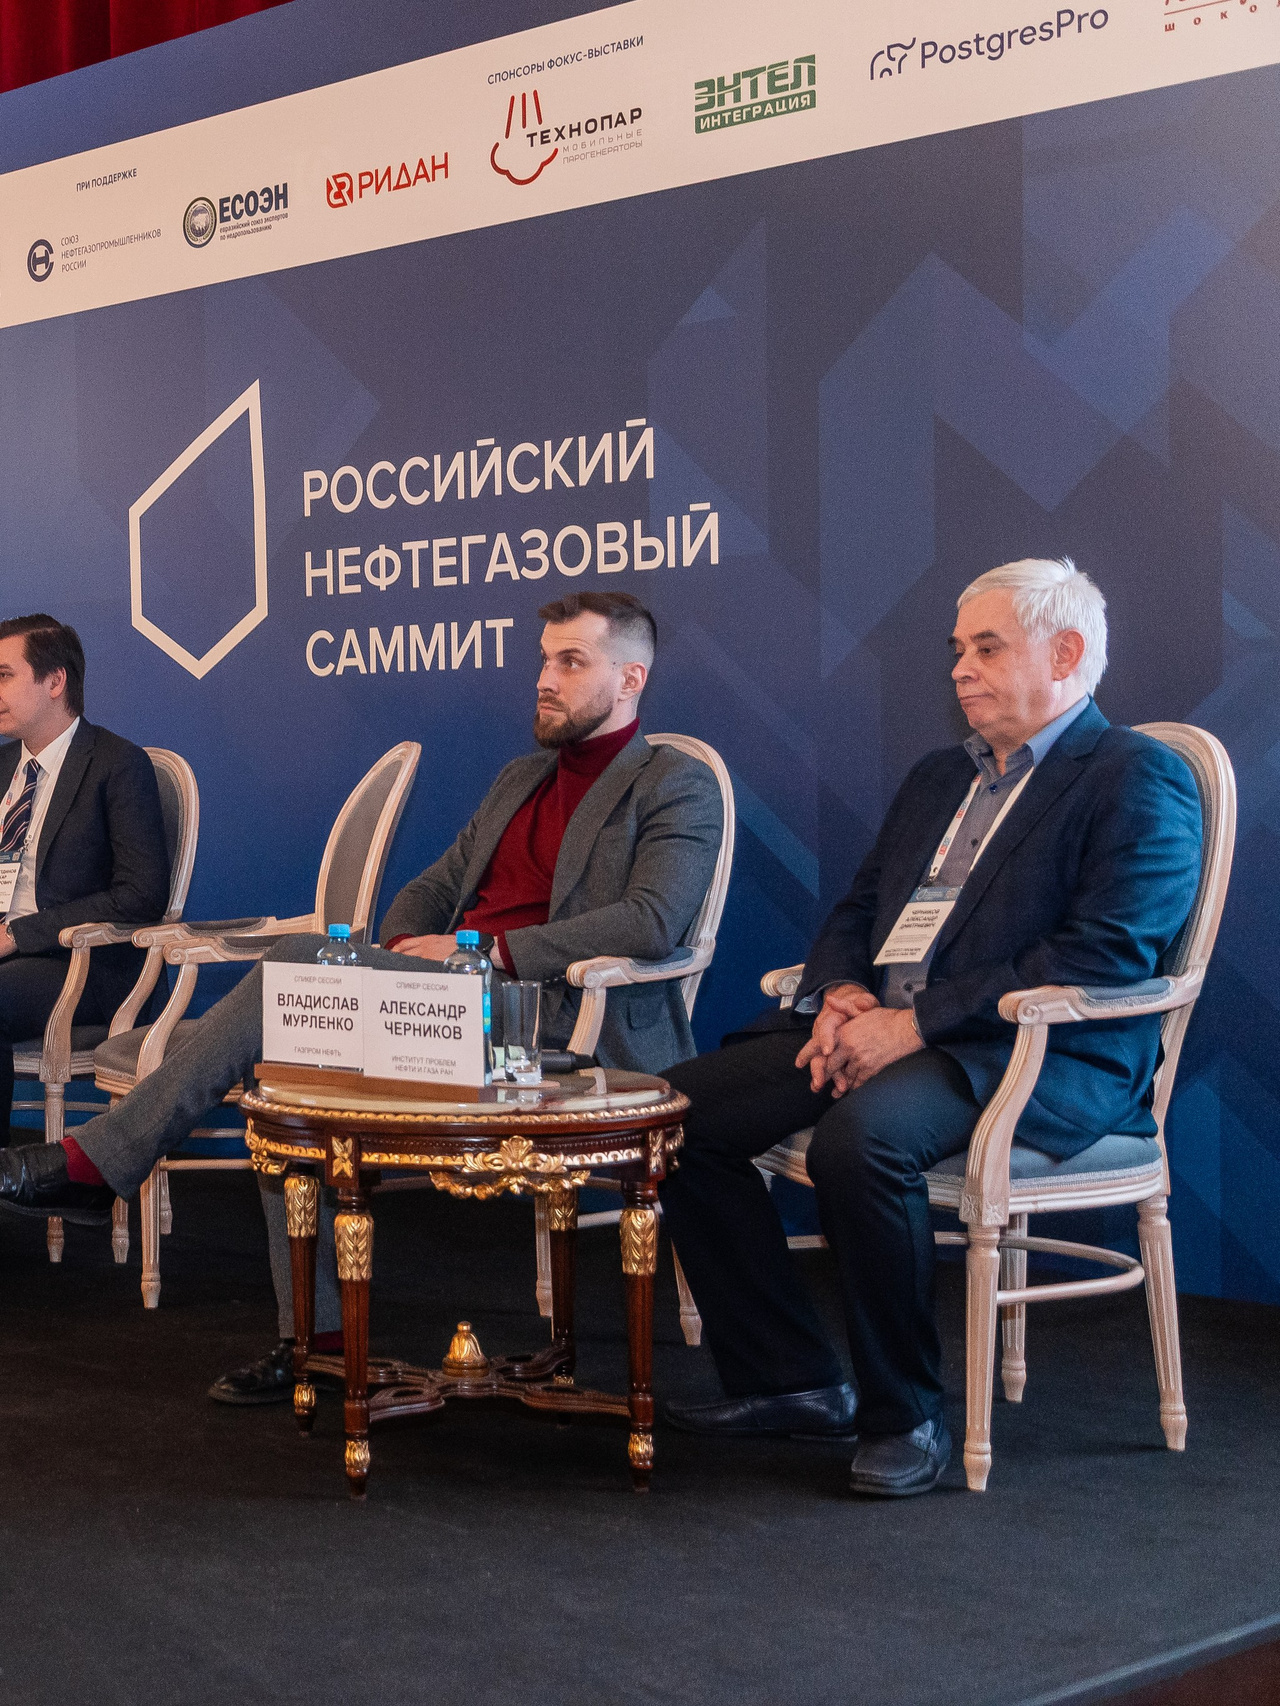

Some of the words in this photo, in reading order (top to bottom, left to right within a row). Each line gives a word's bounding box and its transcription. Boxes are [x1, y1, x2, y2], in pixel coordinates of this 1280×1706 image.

[920, 8, 1110, 69] PostgresPro
[487, 60, 546, 86] СПОНСОРЫ
[547, 35, 644, 70] ФОКУС-ВЫСТАВКИ
[694, 54, 816, 113] ЭНТЕЛ
[700, 92, 811, 130] ИНТЕГРАЦИЯ
[526, 107, 643, 149] ТЕХНОПАР
[562, 128, 643, 154] МОБИЛЬНЫЕ
[562, 140, 643, 164] ПАРОГЕНЕРАТОРЫ
[76, 180, 90, 192] ПРИ
[92, 168, 137, 188] ПОДДЕРЖКЕ
[358, 152, 449, 200] РИДАН
[219, 182, 288, 224] ЕСОЭН
[220, 221, 250, 234] евразийский
[251, 218, 264, 226] союз
[60, 234, 79, 246] СОЮЗ
[62, 228, 162, 259] НЕФТЕГАЗОПРОМЫШЛЕННИКОВ
[62, 260, 86, 273] РОССИИ
[304, 417, 655, 517] РОССИЙСКИЙ
[304, 502, 720, 598] НЕФТЕГАЗОВЫЙ
[306, 618, 514, 678] САММИТ
[294, 975, 317, 984] СПИКЕР
[318, 976, 342, 985] СЕССИИ
[396, 982, 421, 990] СПИКЕР
[422, 982, 448, 992] СЕССИИ
[277, 993, 359, 1012] ВЛАДИСЛАВ
[380, 1000, 467, 1020] АЛЕКСАНДР
[282, 1013, 354, 1032] МУРЛЕНКО
[384, 1021, 462, 1040] ЧЕРНИКОВ
[294, 1046, 320, 1056] ГАЗПРОМ
[322, 1048, 342, 1056] НЕФТЬ
[392, 1056, 422, 1066] ИНСТИТУТ
[423, 1058, 456, 1068] ПРОБЛЕМ
[395, 1064, 414, 1074] НЕФТИ
[416, 1066, 421, 1074] И
[423, 1066, 438, 1075] ГАЗА
[439, 1067, 454, 1076] РАН
